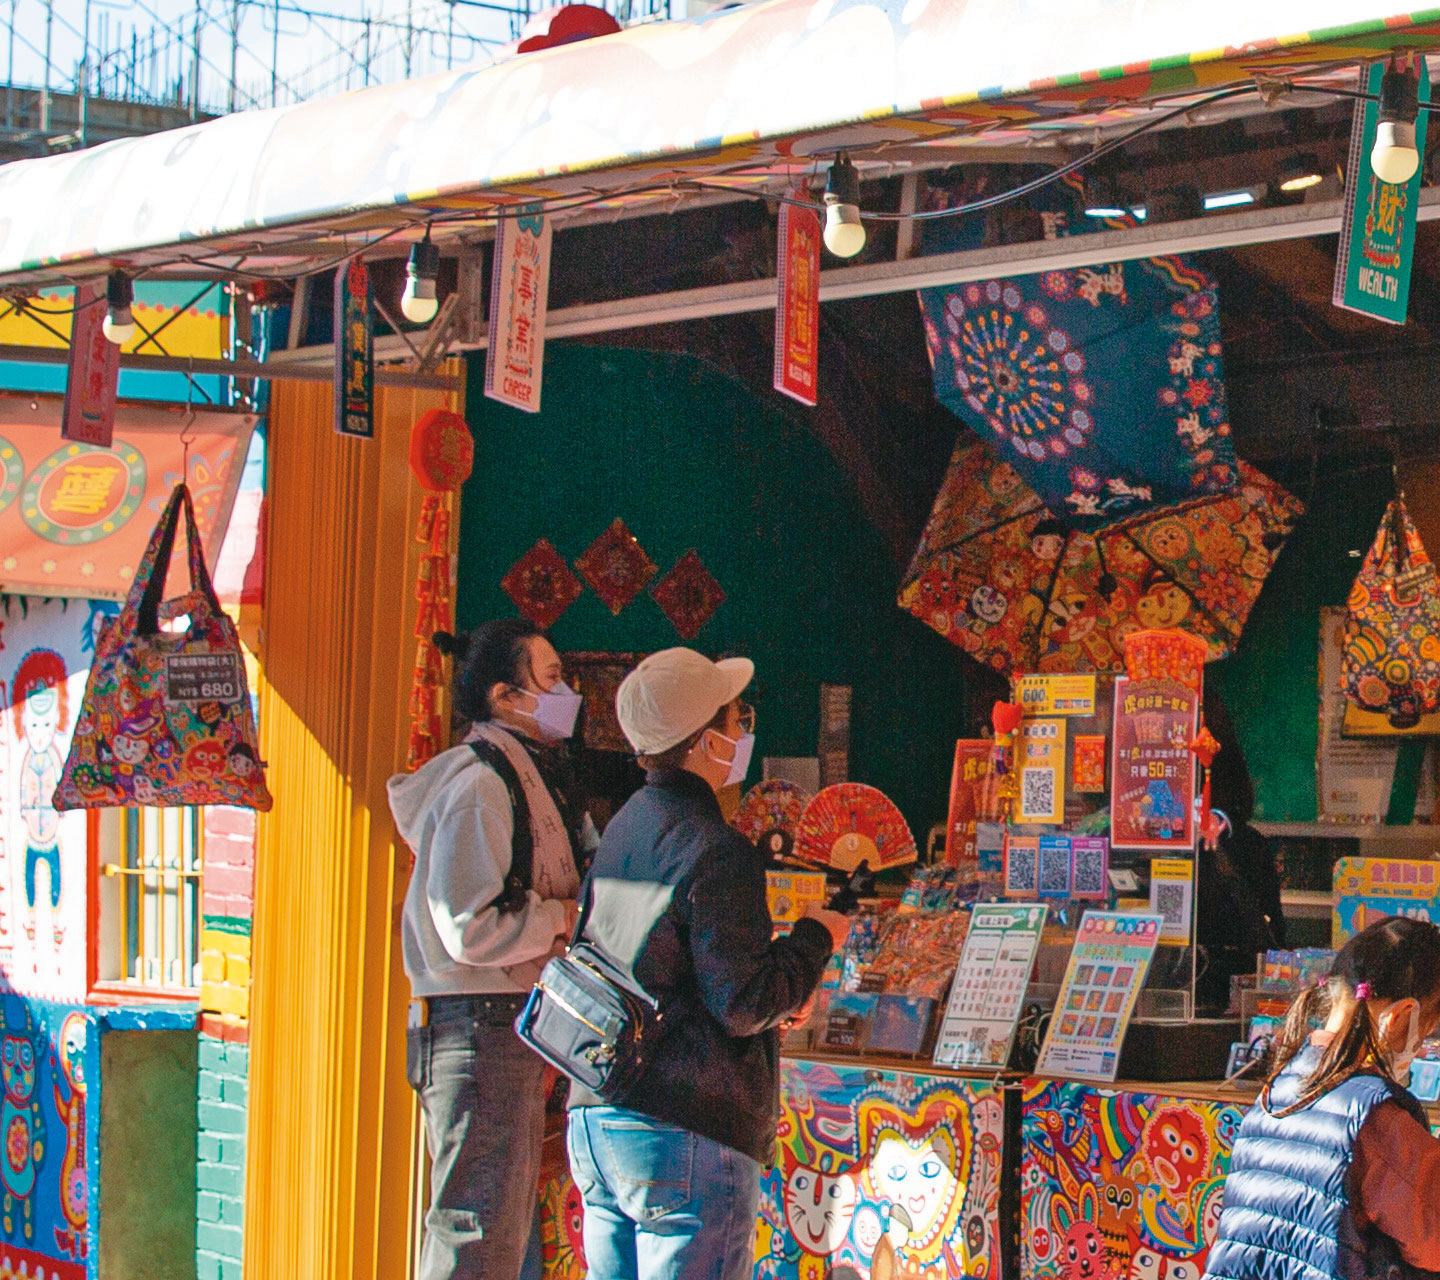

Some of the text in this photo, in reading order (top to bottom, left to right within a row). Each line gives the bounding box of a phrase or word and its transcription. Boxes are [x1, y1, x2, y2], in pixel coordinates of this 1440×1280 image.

[1359, 266, 1398, 302] WEALTH
[503, 376, 532, 404] CAREER
[201, 682, 233, 697] 680
